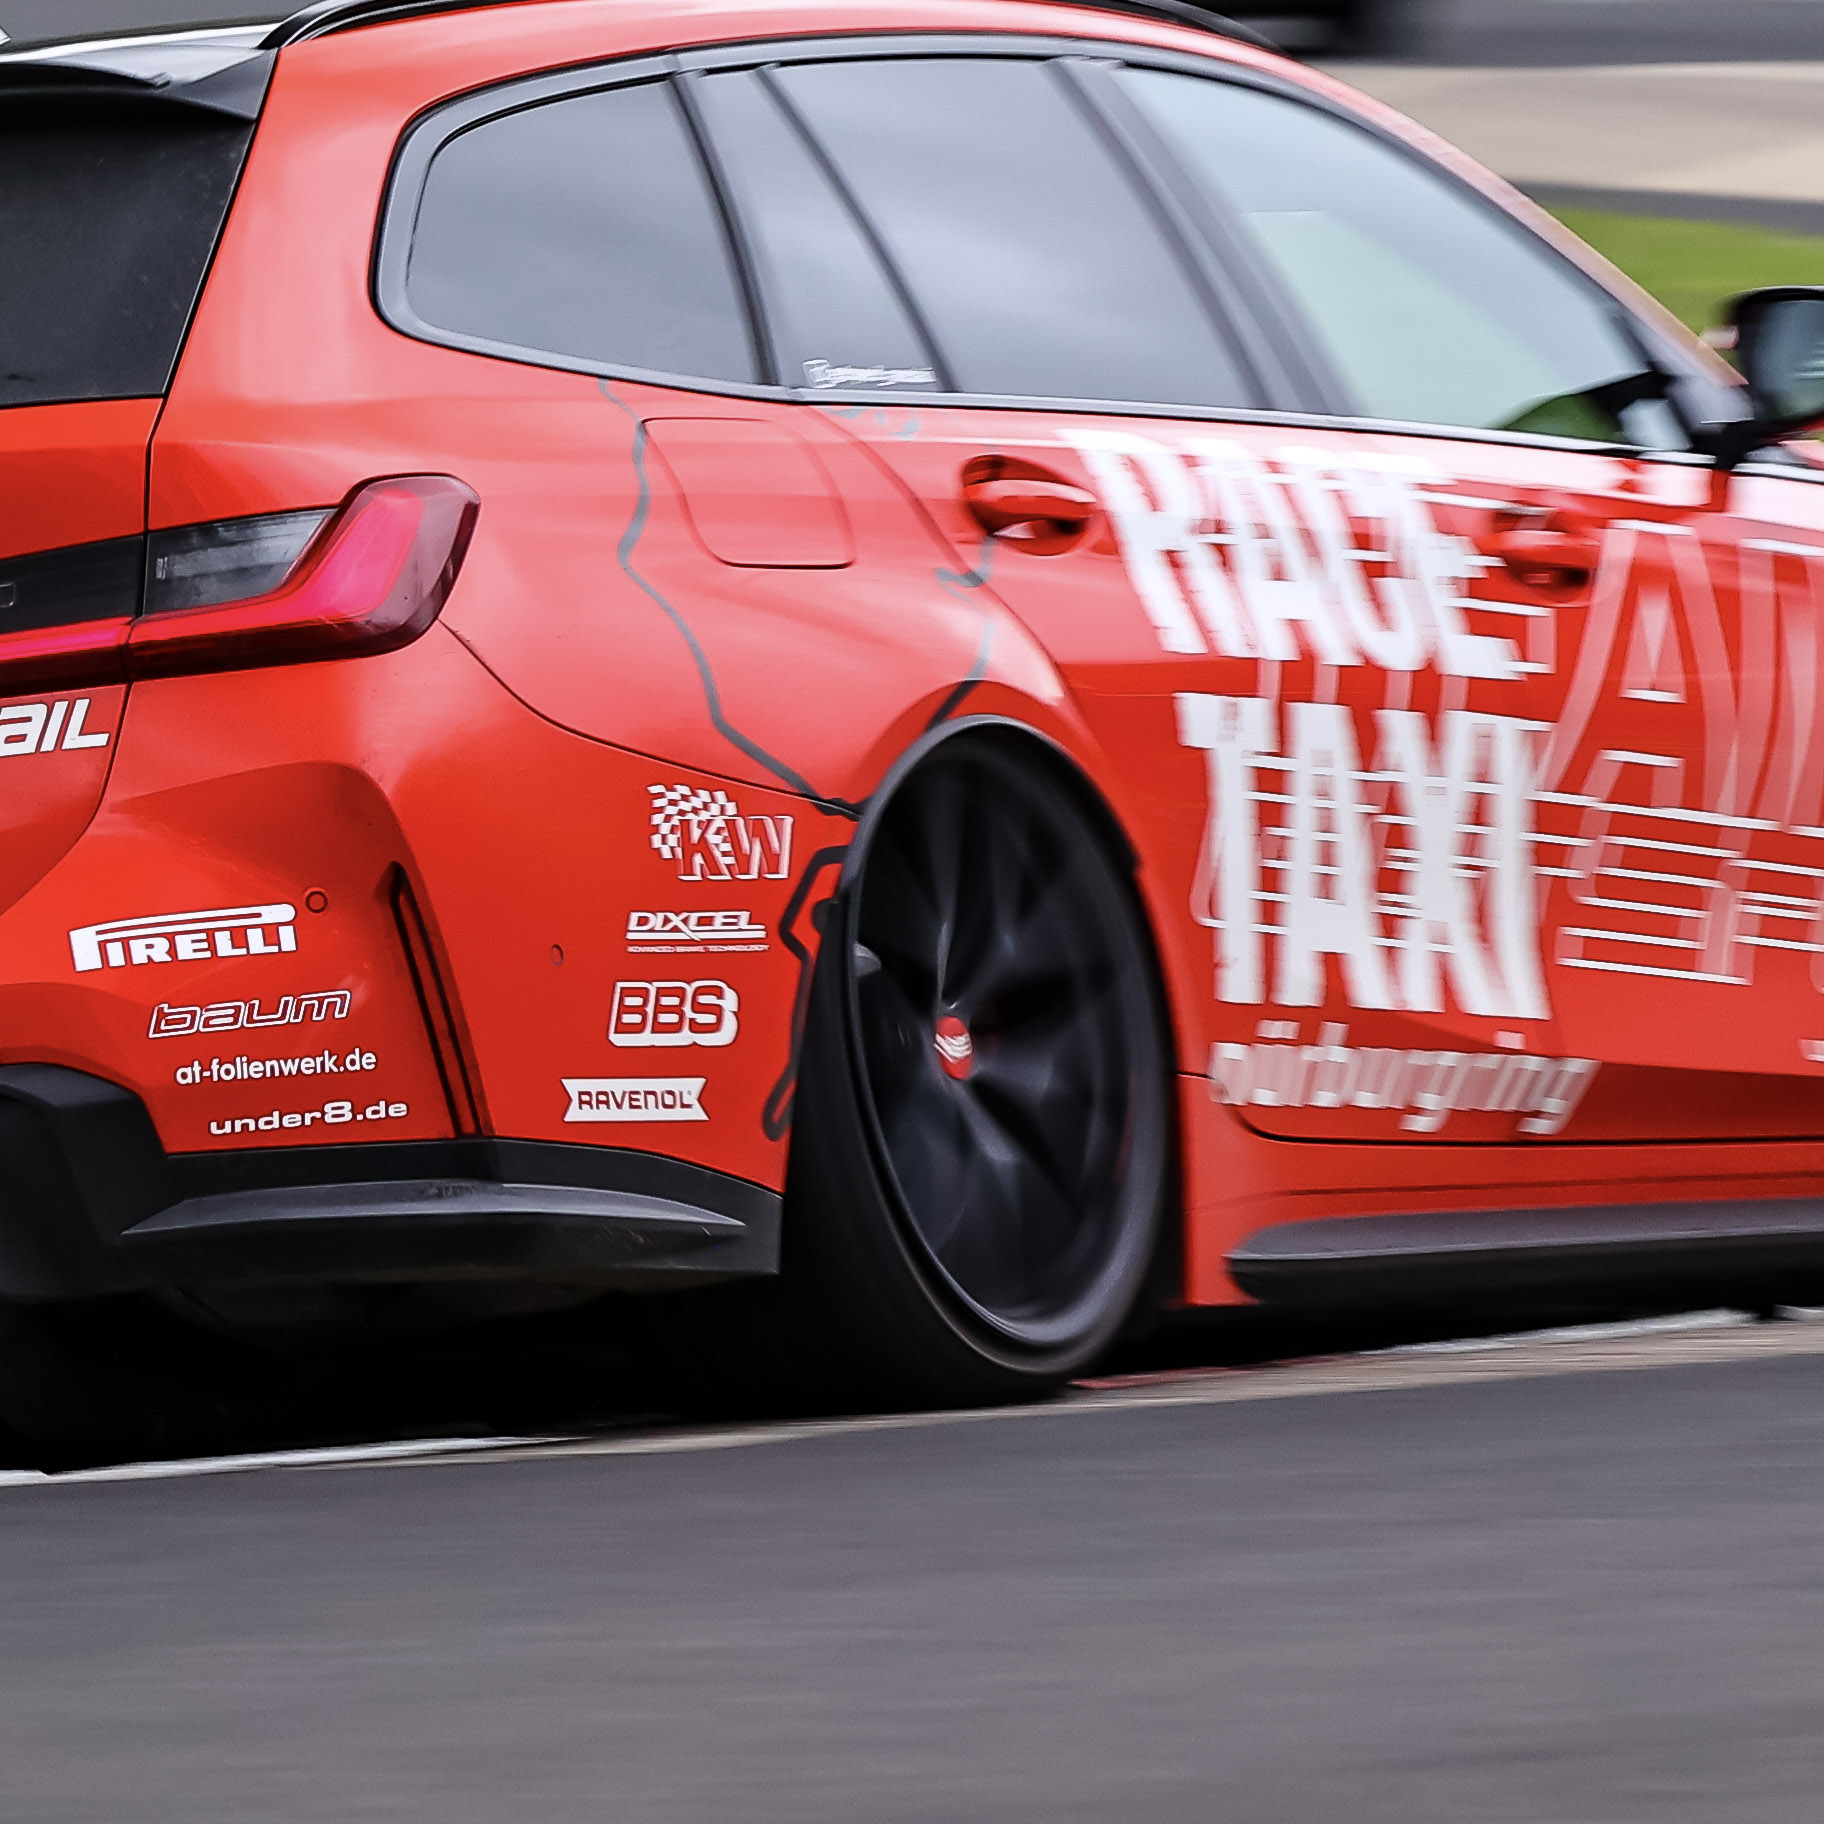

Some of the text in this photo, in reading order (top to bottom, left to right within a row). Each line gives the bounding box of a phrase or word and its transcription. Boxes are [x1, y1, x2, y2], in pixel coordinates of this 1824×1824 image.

[676, 815, 794, 881] KW
[69, 903, 297, 972] PIRELLI
[626, 910, 767, 941] DIXCEL
[148, 990, 351, 1039] baum
[607, 980, 739, 1047] BBS
[175, 1048, 377, 1085] at-folienwerk.de
[209, 1100, 408, 1135] under8.de
